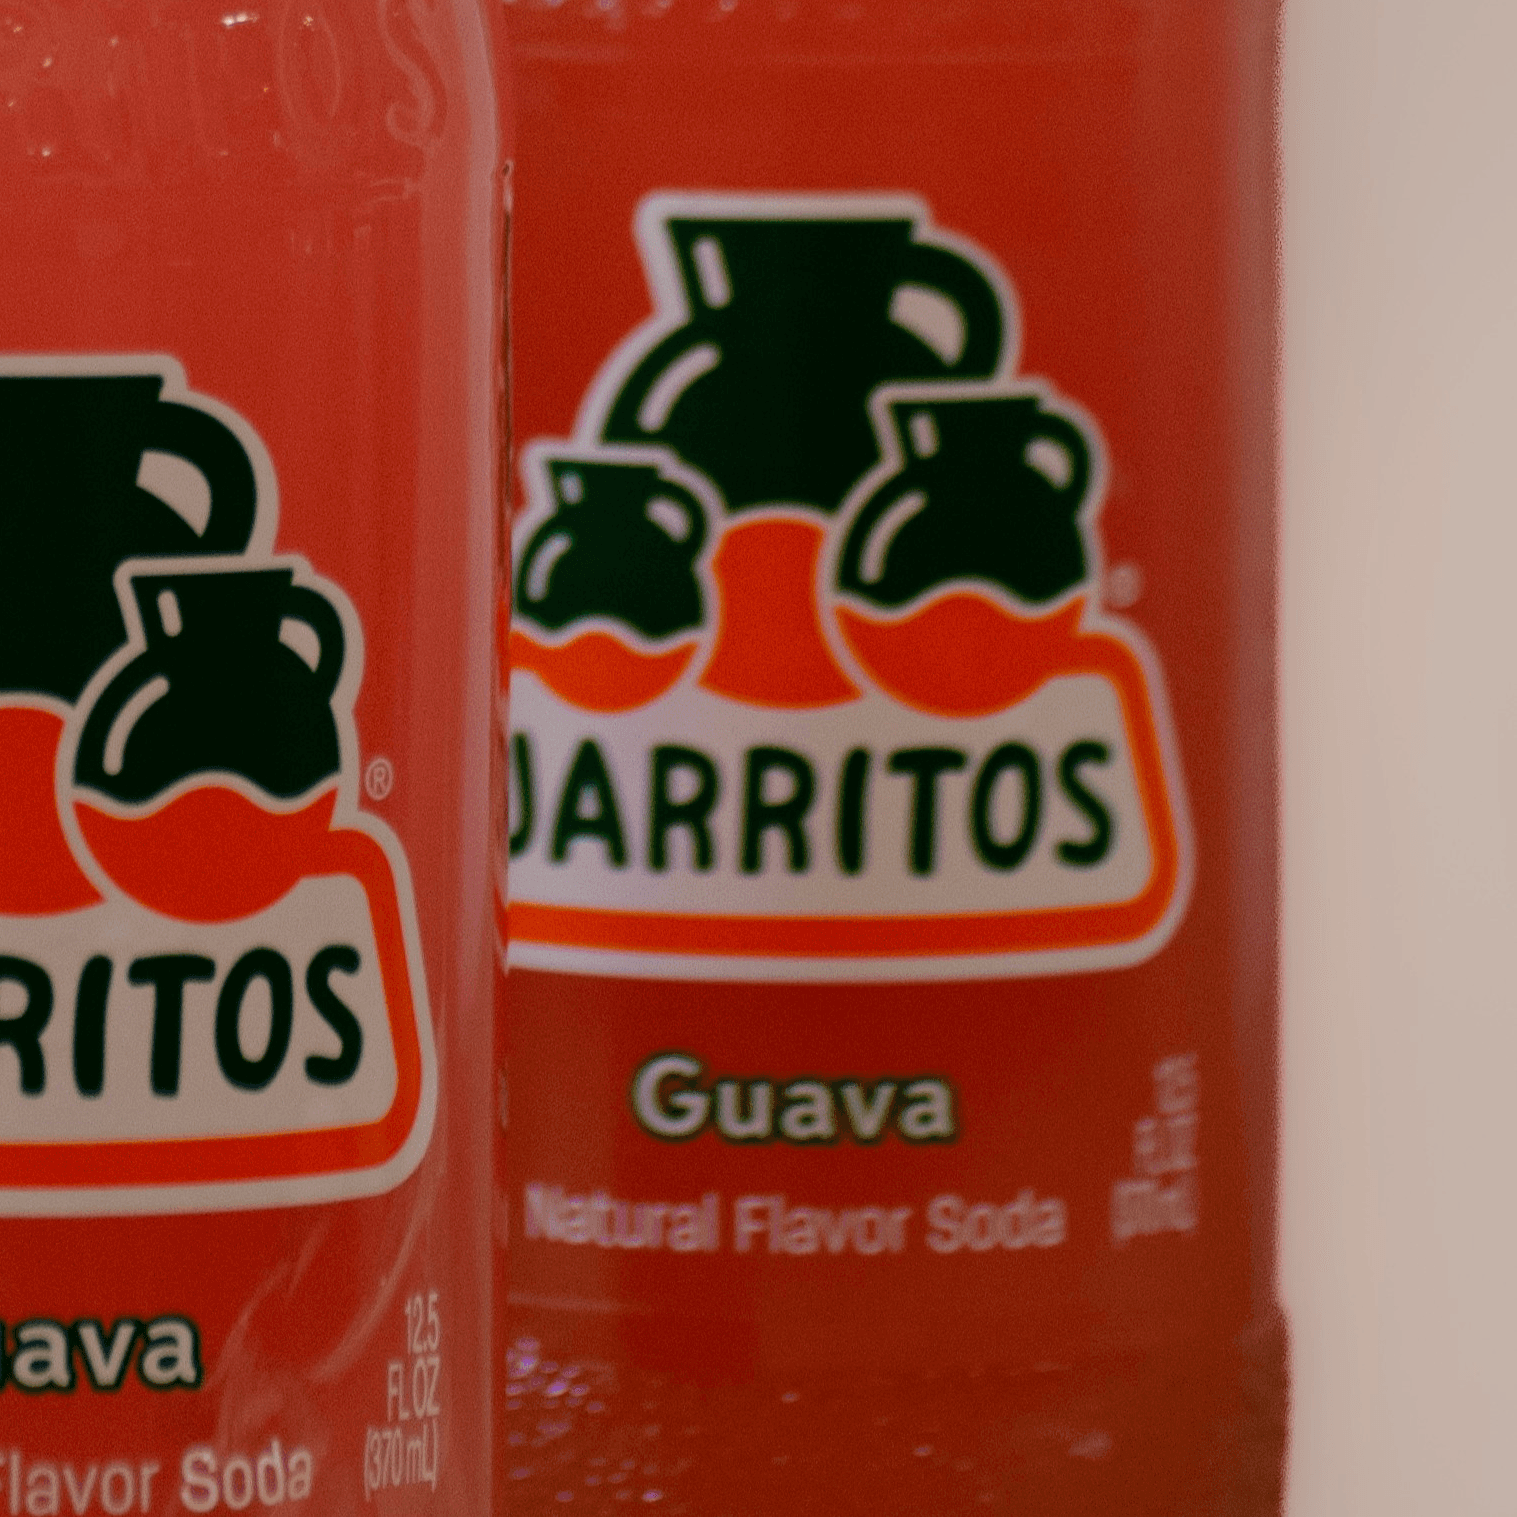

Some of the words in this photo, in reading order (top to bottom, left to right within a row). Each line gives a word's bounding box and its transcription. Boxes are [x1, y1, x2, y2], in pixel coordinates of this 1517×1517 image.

[632, 1052, 959, 1146] Guava
[524, 1183, 720, 1252] Natural
[734, 1194, 914, 1256] Flavor
[926, 1188, 1068, 1254] Soda
[405, 1290, 440, 1356] 12.5
[387, 1360, 410, 1423] FL
[412, 1355, 441, 1420] OZ
[181, 1437, 314, 1512] Soda
